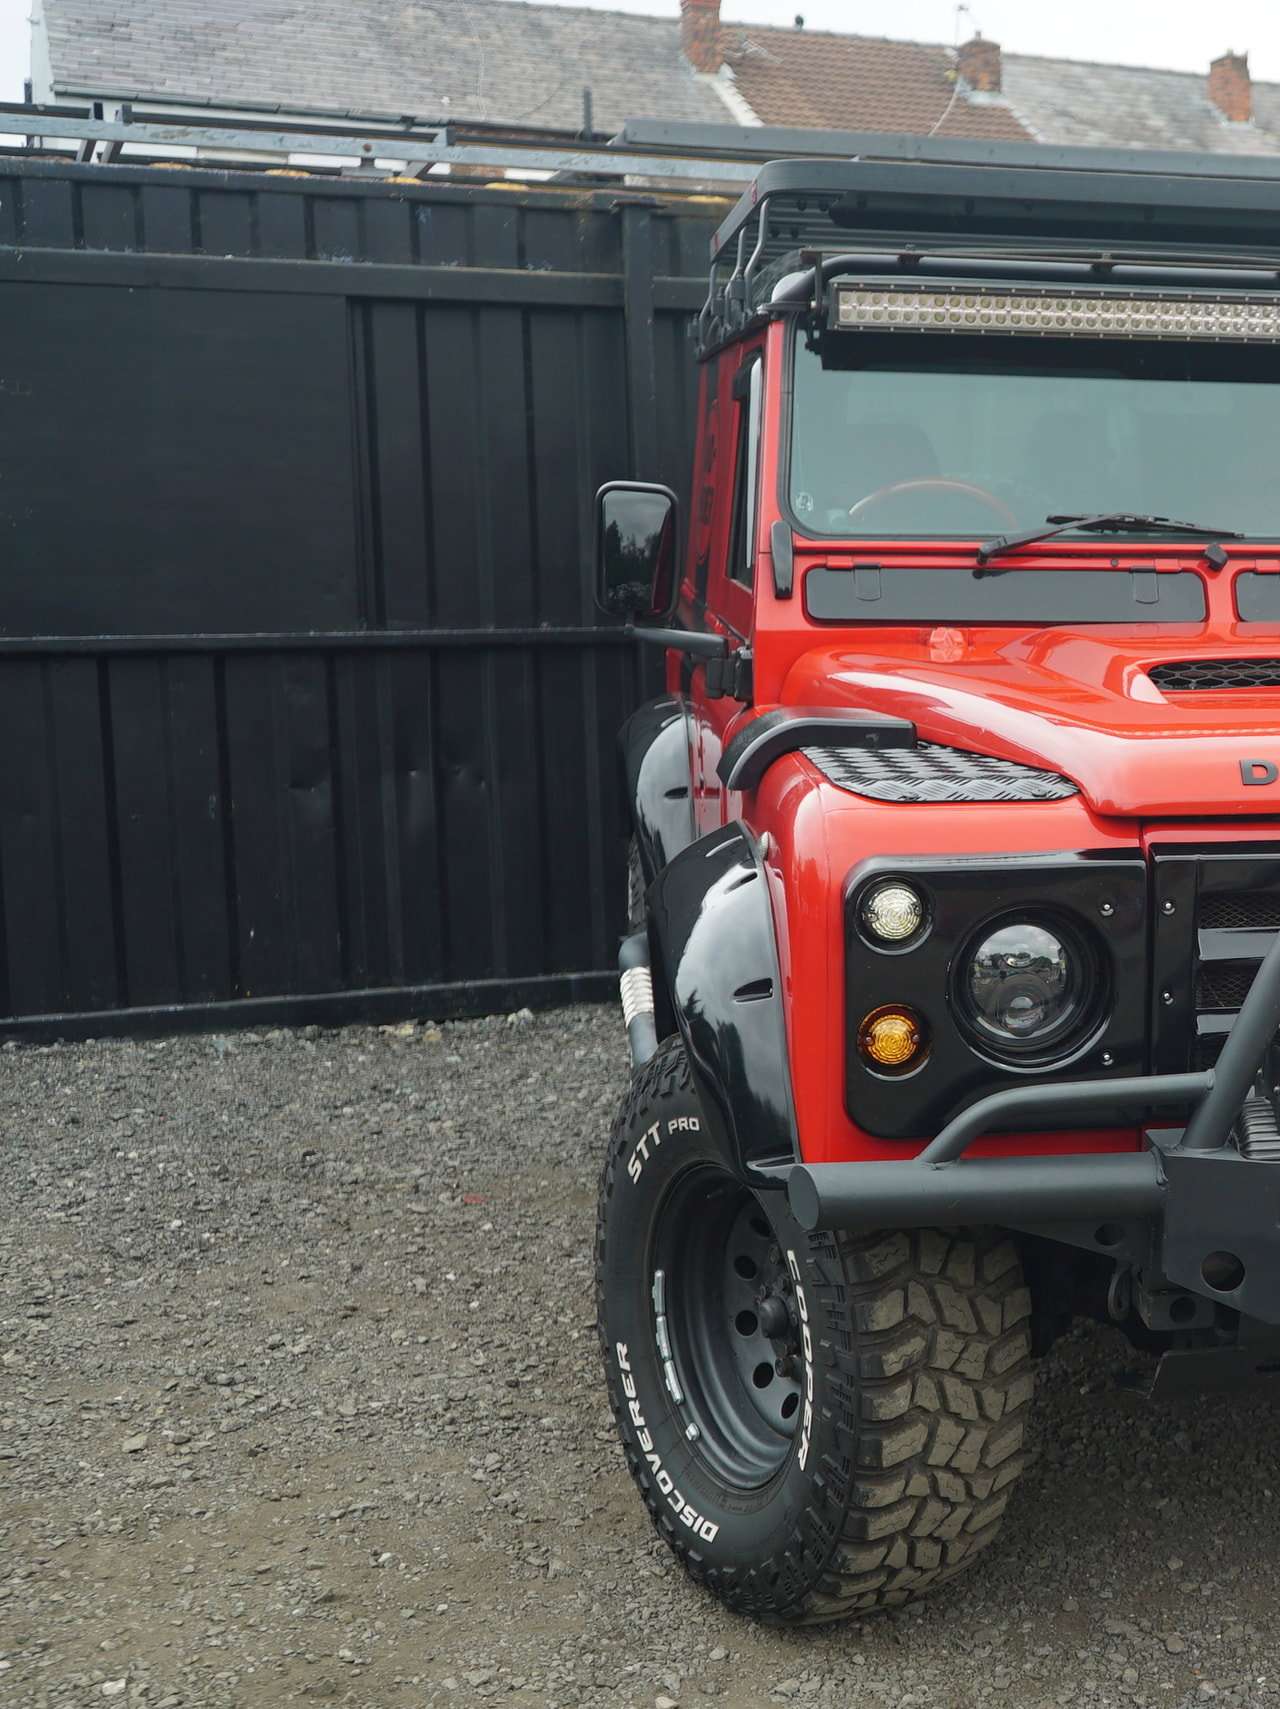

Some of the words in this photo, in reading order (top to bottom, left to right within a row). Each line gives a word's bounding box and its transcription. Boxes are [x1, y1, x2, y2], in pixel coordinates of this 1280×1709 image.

[627, 1120, 661, 1185] STT
[667, 1116, 700, 1135] PRO
[616, 1342, 720, 1544] DISCOVERER
[786, 1250, 813, 1472] COOPER
